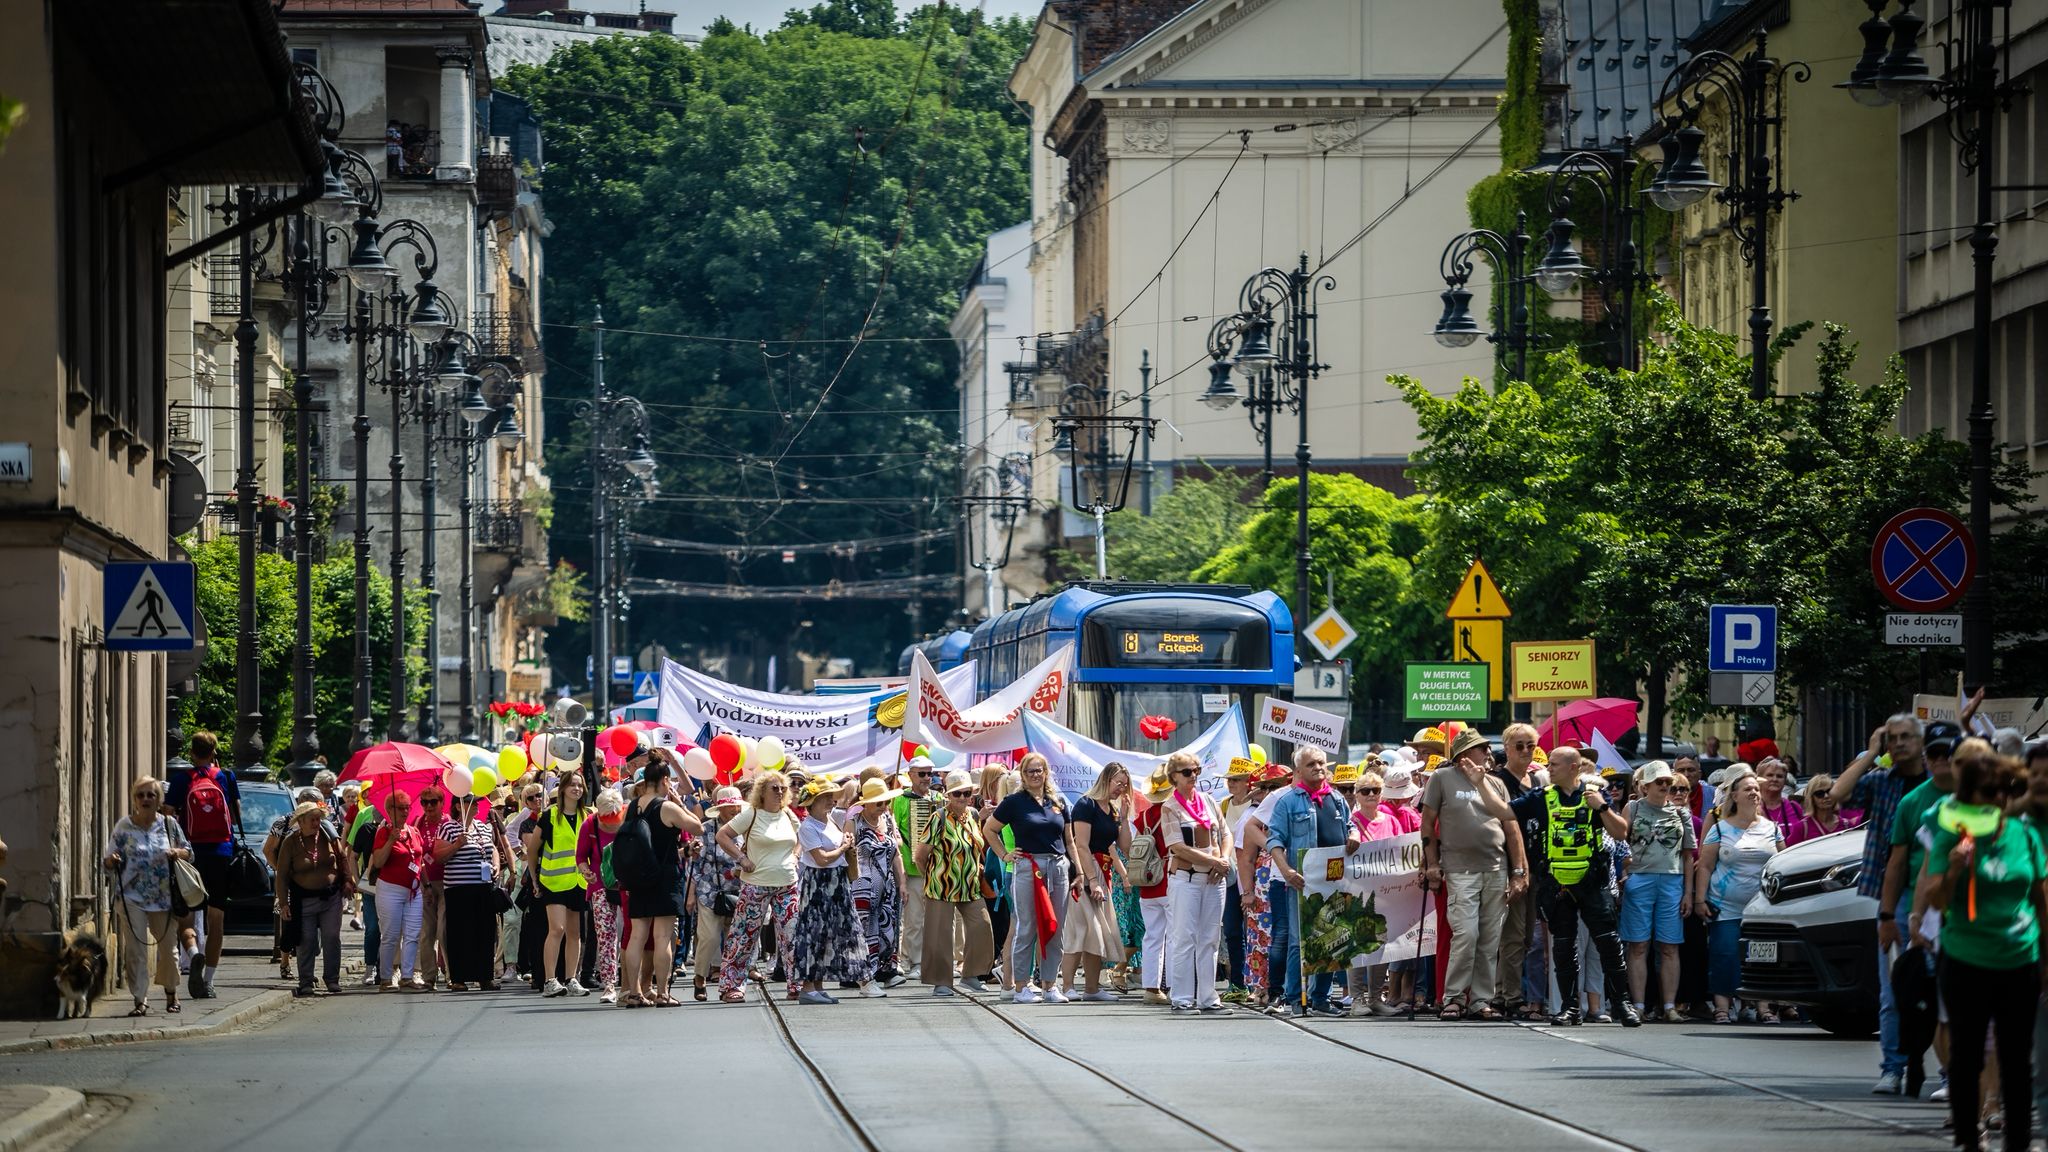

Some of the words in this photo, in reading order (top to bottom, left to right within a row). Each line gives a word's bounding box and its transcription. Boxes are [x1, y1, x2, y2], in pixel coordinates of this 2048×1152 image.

[1, 461, 24, 476] SKA
[1889, 615, 1911, 627] Nie
[1914, 615, 1959, 630] dotyczy
[1127, 633, 1136, 652] 8
[1163, 633, 1200, 643] Borek
[1724, 613, 1761, 664] P
[1896, 633, 1952, 644] chodnika
[1158, 643, 1204, 654] Fałęcki
[1528, 651, 1581, 662] SENIORZY
[1737, 655, 1767, 667] Płatny
[1423, 671, 1432, 679] W
[1433, 671, 1471, 679] METRYCE
[1551, 667, 1558, 676] Z
[1420, 682, 1450, 690] DŁUGIE
[1451, 682, 1474, 691] LATA,
[1522, 680, 1589, 691] PRUSZKOWA
[1429, 693, 1452, 701] CIELE
[1453, 693, 1481, 701] DUSZA
[1295, 718, 1333, 736] MIEJSKA
[1262, 723, 1287, 738] RADA
[1288, 730, 1337, 750] SENIORÓW
[1051, 764, 1092, 776] DZIŃSKI
[1352, 848, 1398, 880] GMINA
[1402, 843, 1421, 871] KO
